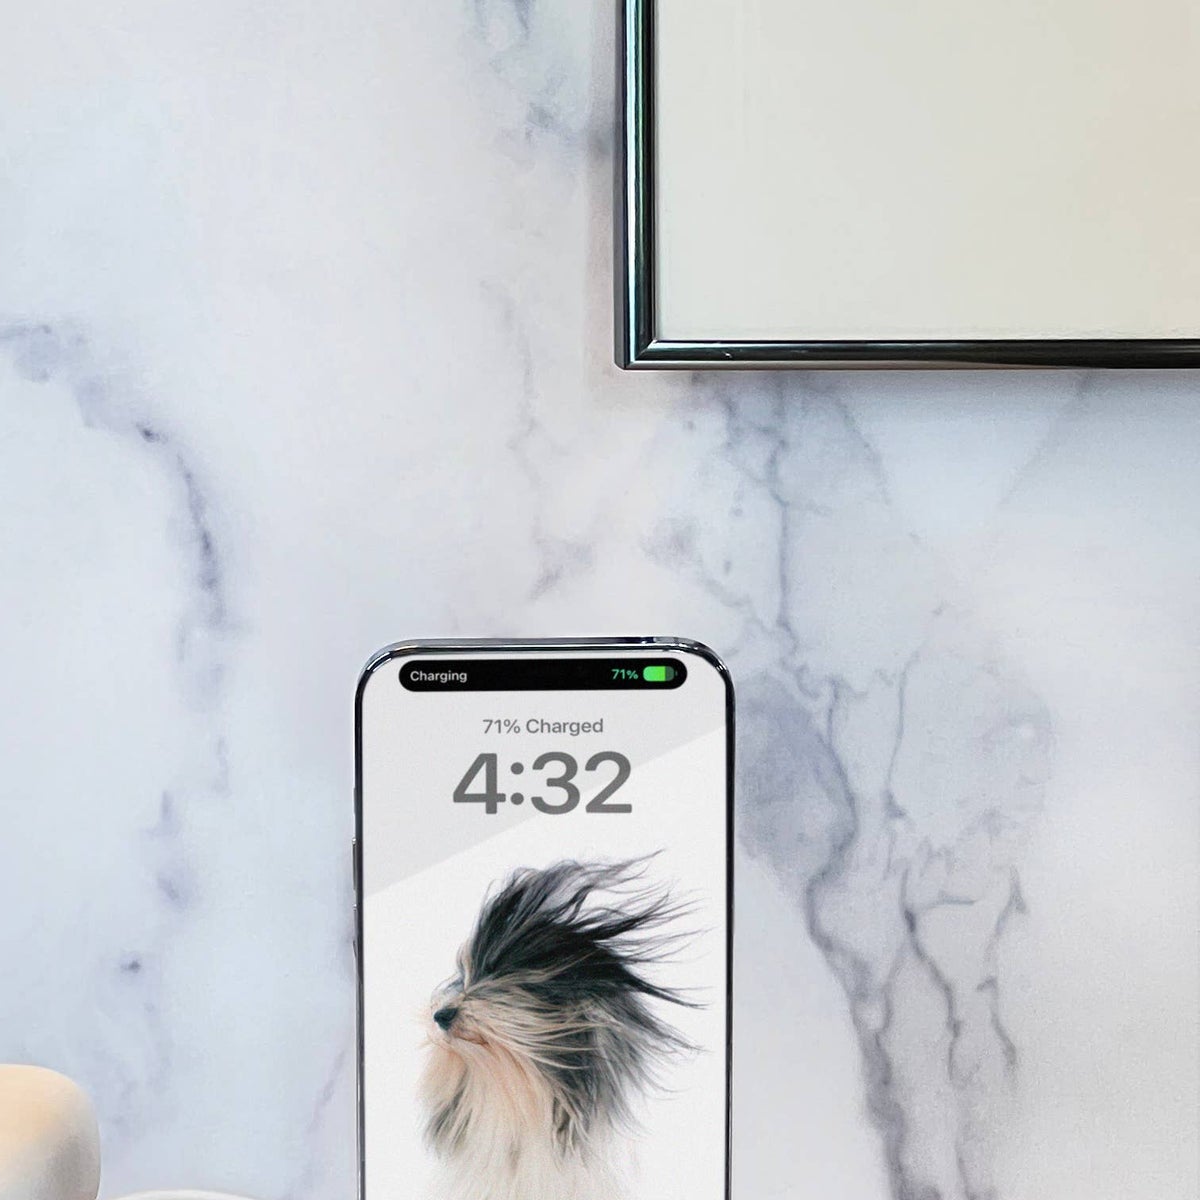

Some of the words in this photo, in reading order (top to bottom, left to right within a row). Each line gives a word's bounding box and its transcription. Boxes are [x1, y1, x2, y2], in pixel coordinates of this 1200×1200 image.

[410, 670, 467, 683] Charging
[611, 669, 639, 680] 71%
[482, 719, 521, 734] 71%
[525, 718, 604, 736] Charged
[452, 750, 632, 815] 4:32
